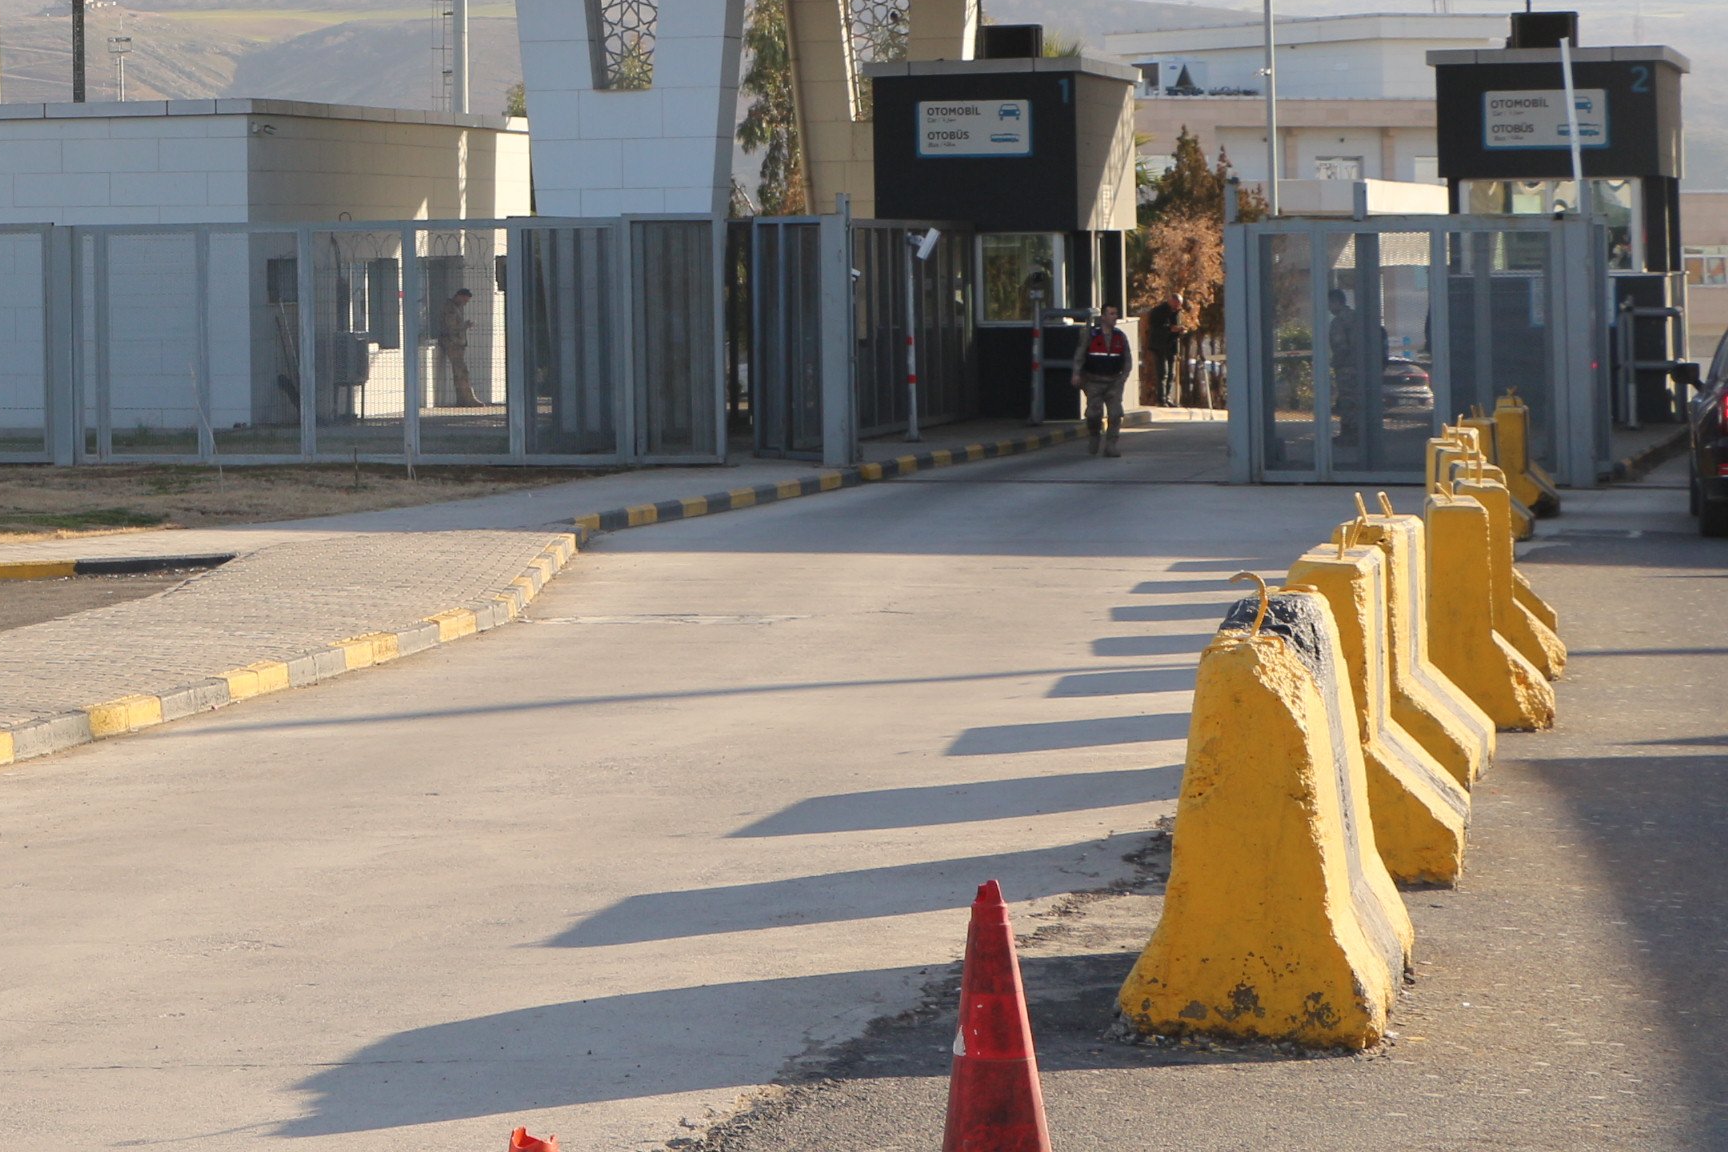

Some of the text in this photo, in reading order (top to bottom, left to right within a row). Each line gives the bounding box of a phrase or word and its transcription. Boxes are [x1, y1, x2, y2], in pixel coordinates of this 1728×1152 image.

[1631, 66, 1649, 93] 2
[1058, 78, 1070, 104] 1
[1490, 97, 1549, 109] OTOMOBİL
[927, 104, 981, 116] OTOMOBİL
[1492, 122, 1534, 134] OTOBÜS
[927, 129, 970, 140] OTOBÜS
